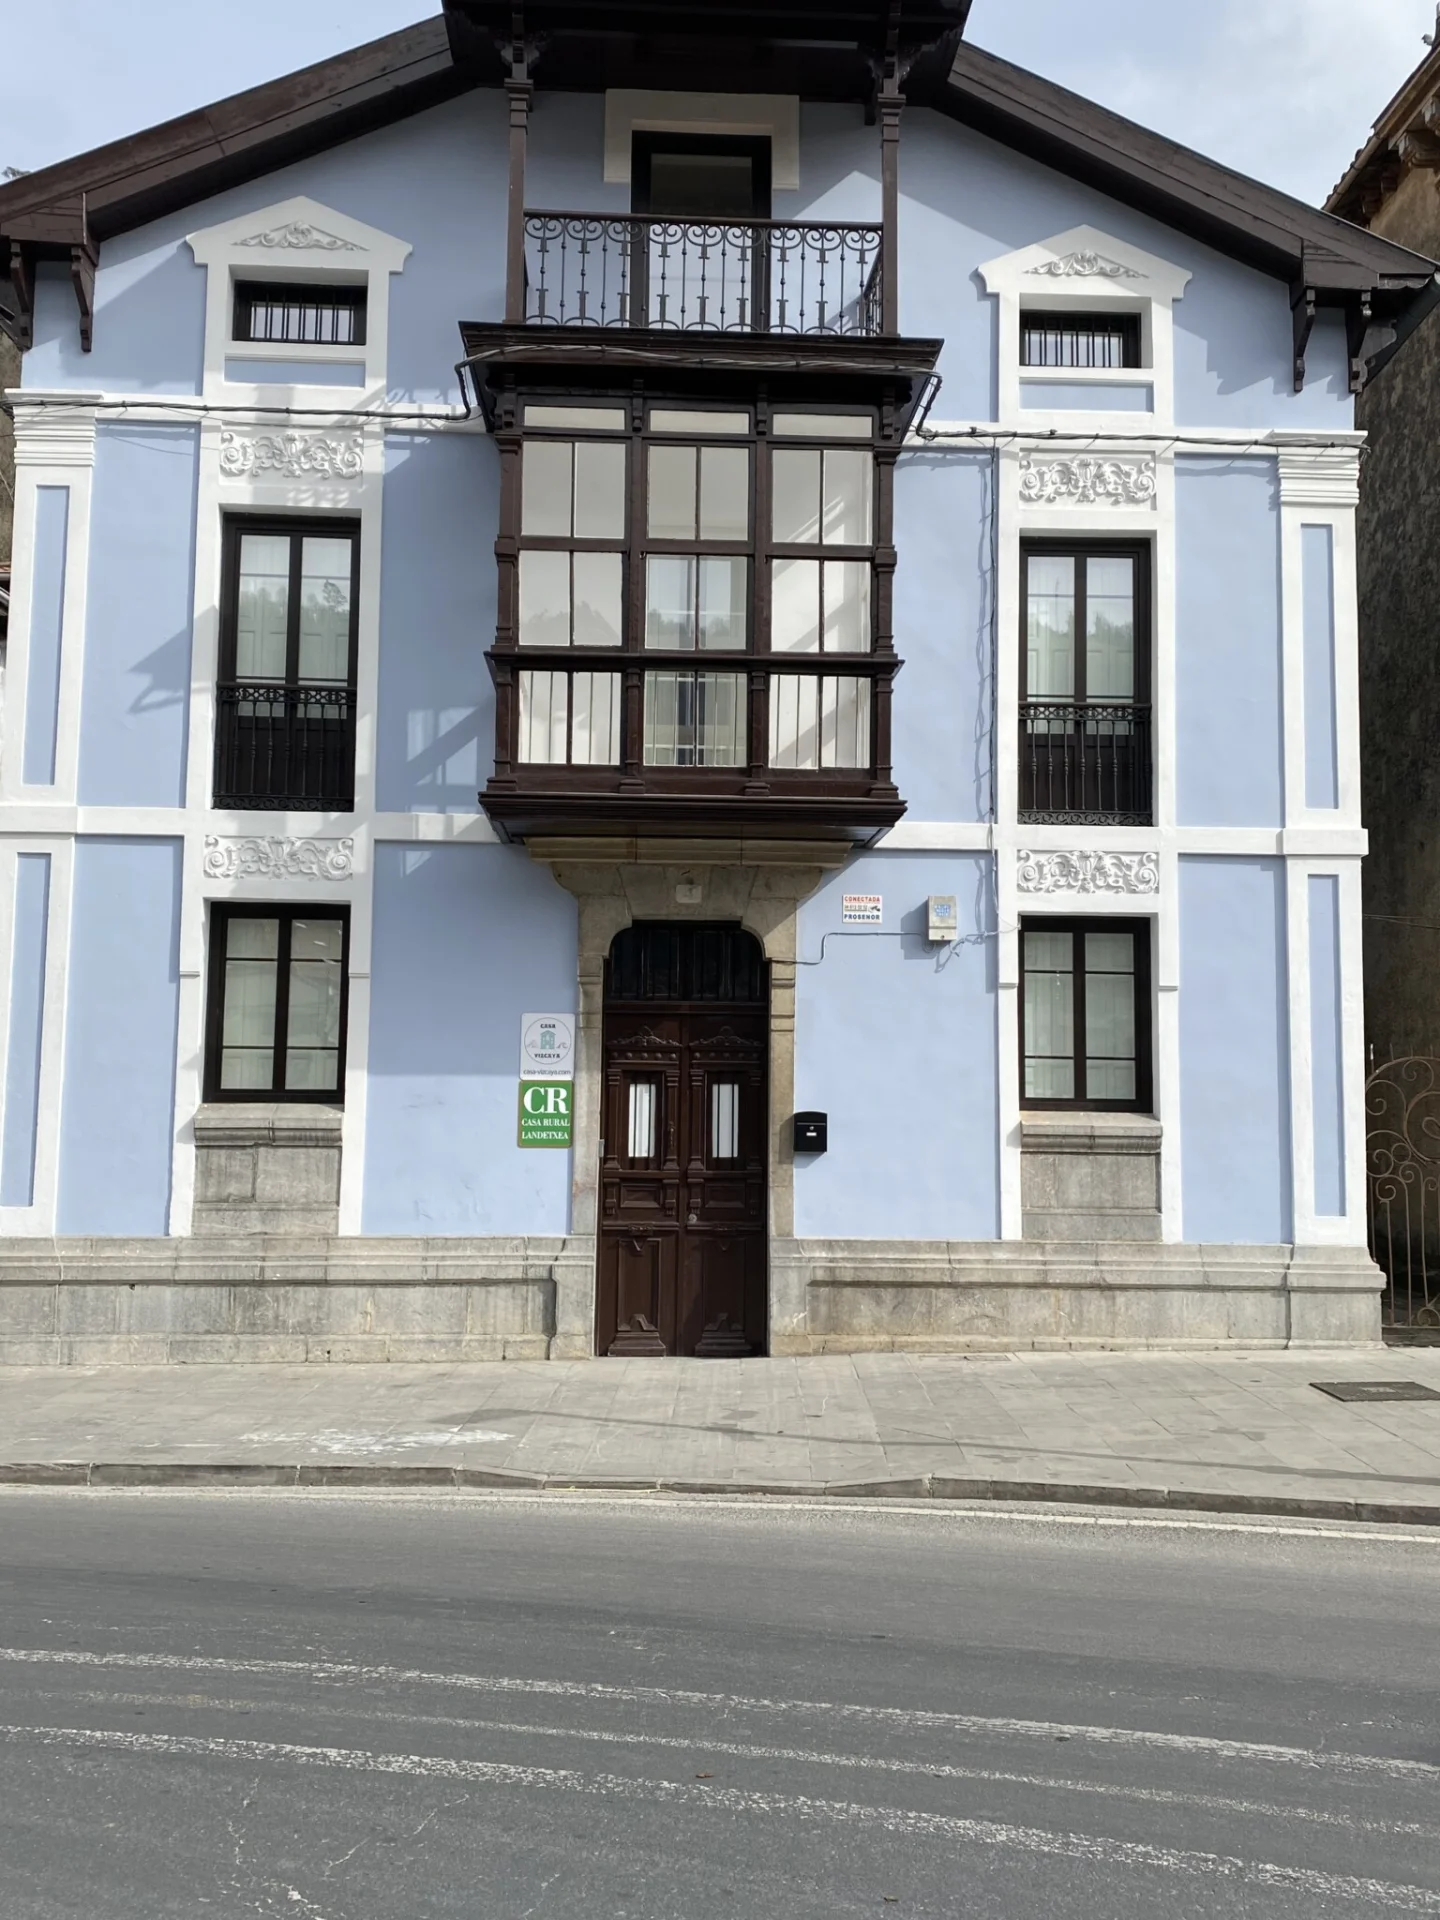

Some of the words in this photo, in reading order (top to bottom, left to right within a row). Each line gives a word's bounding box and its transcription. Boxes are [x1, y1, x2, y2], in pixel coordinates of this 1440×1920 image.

[523, 1068, 571, 1076] casa-vizcaya.com
[523, 1086, 570, 1114] CR
[521, 1118, 542, 1126] CASA
[543, 1118, 570, 1127] RURAL
[521, 1131, 568, 1140] LANDETXEA
